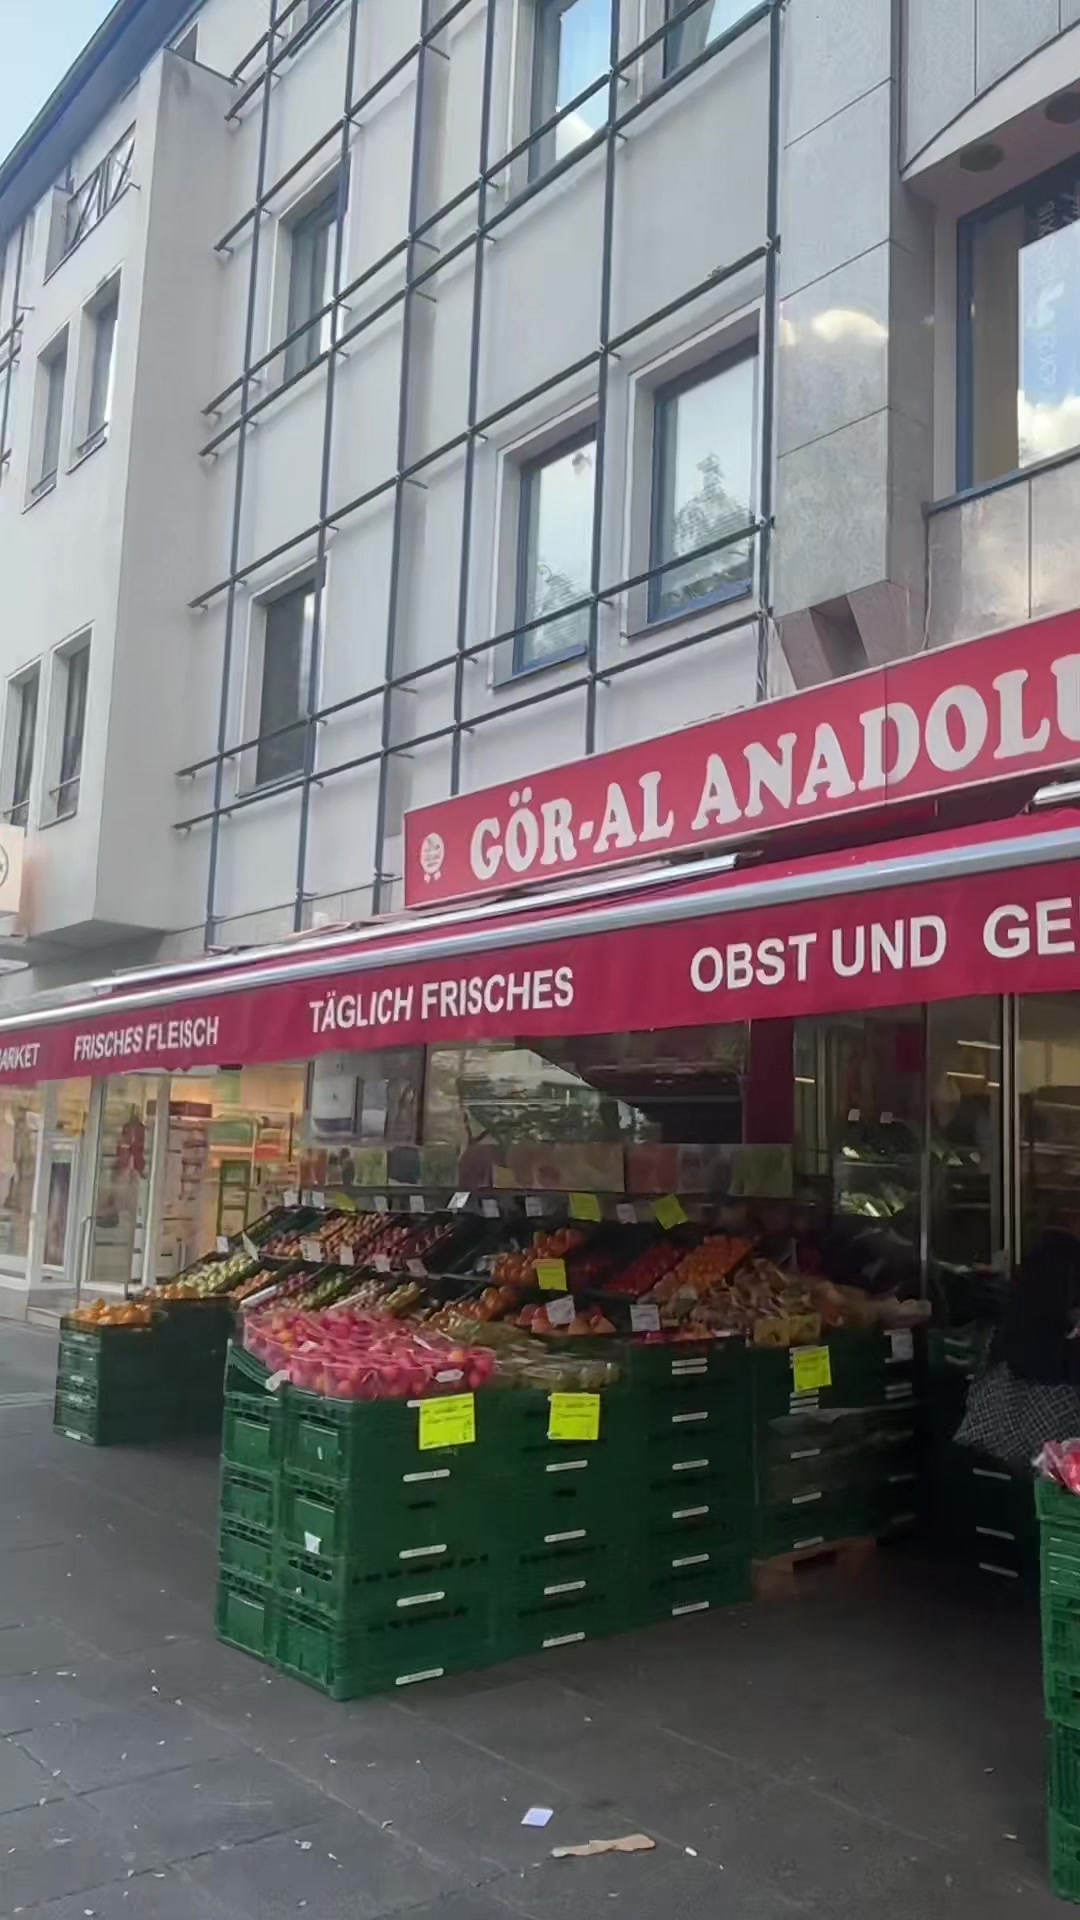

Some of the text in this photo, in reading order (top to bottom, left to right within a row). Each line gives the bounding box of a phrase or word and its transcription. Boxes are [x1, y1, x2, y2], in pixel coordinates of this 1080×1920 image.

[470, 771, 675, 881] GÖR-AL
[690, 897, 1080, 993] OBST UND GE
[309, 966, 574, 1034] TÄGLICH FRISCHES
[0, 1042, 41, 1072] ARKET
[73, 1016, 220, 1062] FRISCHES FLEISCH
